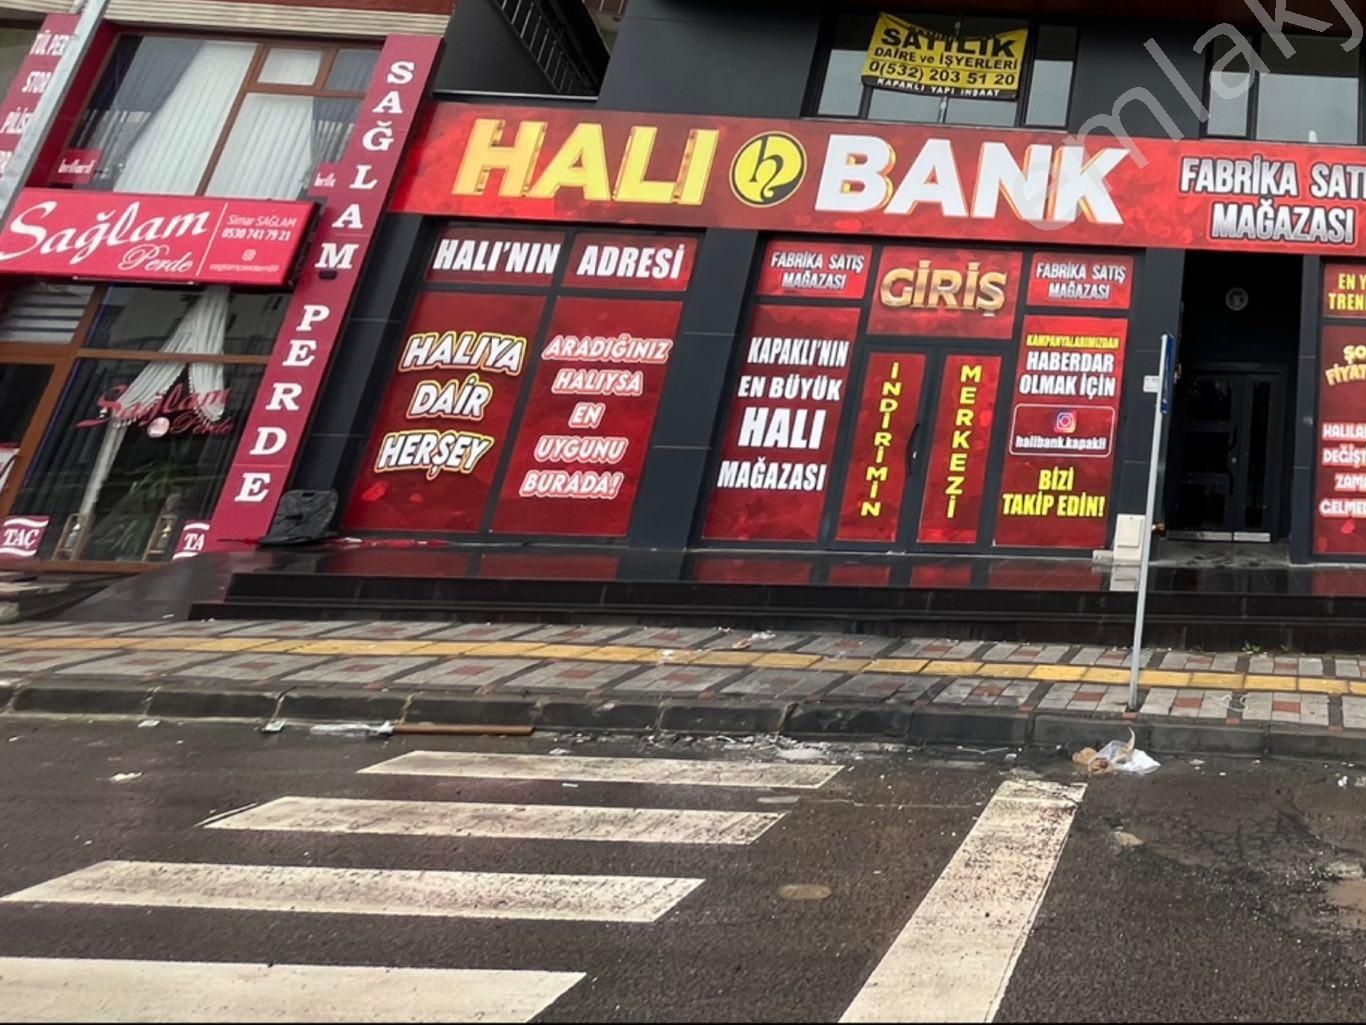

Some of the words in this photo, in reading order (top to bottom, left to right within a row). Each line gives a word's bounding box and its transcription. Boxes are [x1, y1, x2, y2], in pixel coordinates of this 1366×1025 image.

[49, 34, 70, 56] PER
[874, 47, 916, 63] DAİRE
[920, 55, 934, 64] ve
[881, 27, 1017, 58] SATILIK
[869, 60, 924, 82] 0(532)
[930, 69, 960, 83] 203
[967, 72, 986, 84] 51
[994, 74, 1015, 85] 20
[877, 78, 924, 91] KAPAKLI
[931, 86, 954, 95] YAPI
[315, 61, 414, 269] SAĞLAM
[452, 119, 719, 205] HALI
[815, 134, 1129, 225] BANK
[1180, 153, 1298, 196] FABRİKA
[0, 201, 210, 265] Sağlam
[1211, 199, 1355, 244] MAĞAZASI
[118, 244, 194, 272] Perde
[433, 238, 562, 275] HALI'NIN
[576, 244, 684, 279] ADRESİ
[770, 252, 824, 270] FABRİKA
[829, 254, 864, 273] SATIŞ
[1036, 260, 1087, 280] FABRİKA
[1091, 264, 1126, 283] SATIŞ
[781, 270, 846, 290] MAĞAZASI
[880, 259, 1006, 316] GİRİŞ
[1048, 280, 1110, 300] MAĞAZASI
[1338, 274, 1356, 291] EN
[399, 332, 527, 376] HALIYA
[542, 334, 673, 364] ARADIĞINIZ
[747, 336, 850, 368] KAPAKLI'NIN
[1026, 352, 1114, 373] HABERDAR
[406, 374, 492, 420] DAİR
[552, 370, 643, 396] HALIYSA
[737, 376, 770, 399] EN
[771, 374, 842, 402] BÜYÜK
[1019, 374, 1077, 396] OLMAK
[1080, 374, 1116, 400] İÇİN
[234, 306, 329, 503] PERDE
[568, 403, 606, 428] EN
[737, 407, 826, 449] HALI
[861, 362, 901, 517] İNDİRİMİN
[946, 364, 982, 518] MERKEZİ
[374, 429, 493, 479] HERŞEY
[533, 436, 628, 464] UYGUNU
[520, 471, 624, 499] BURADA!
[717, 457, 828, 491] MAĞAZASI
[1039, 467, 1074, 491] BİZİ
[1003, 491, 1054, 516] TAKİP
[1057, 492, 1105, 517] EDİN!
[4, 529, 40, 549] TAÇ
[184, 534, 205, 551] TA
